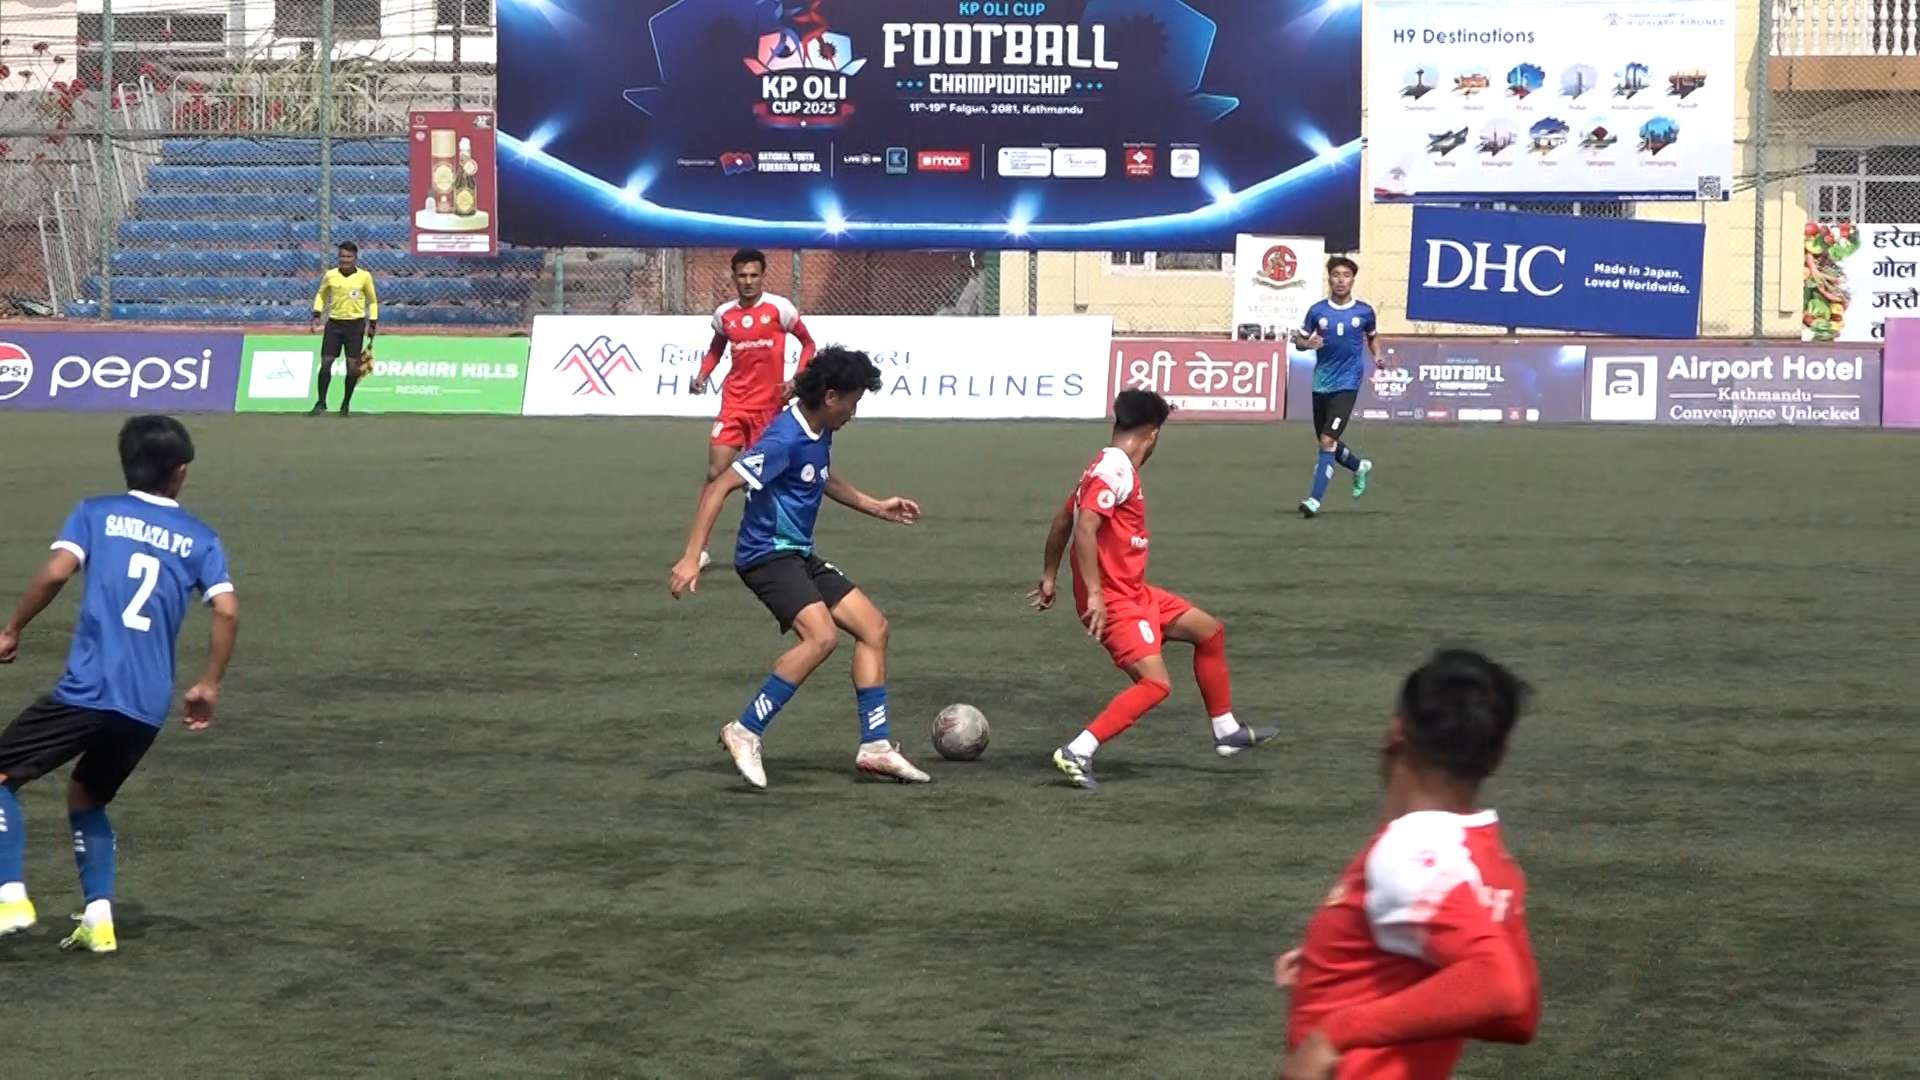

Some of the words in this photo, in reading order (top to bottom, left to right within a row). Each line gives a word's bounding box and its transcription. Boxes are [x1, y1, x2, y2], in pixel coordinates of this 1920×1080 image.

[959, 2, 980, 16] KP
[983, 3, 1009, 16] OLI
[1013, 3, 1045, 16] CUP
[1394, 28, 1416, 44] H9
[1423, 28, 1535, 44] Destinations
[882, 23, 1119, 70] FOOTBALL
[762, 75, 797, 99] KP
[803, 75, 847, 99] OLI
[929, 73, 1072, 95] CHAMPIONSHIP
[772, 101, 800, 114] CUP
[803, 101, 836, 114] 2025
[1023, 104, 1084, 115] Kathmandu
[758, 152, 790, 162] NATIONAL
[793, 152, 815, 162] YOUTH
[758, 163, 799, 173] FEDERATION
[800, 163, 822, 173] NEPAL
[1422, 239, 1566, 296] DHC
[1594, 262, 1626, 276] Made
[1629, 264, 1640, 276] in
[1643, 267, 1683, 280] Japan.
[1873, 256, 1917, 278] गोल
[1585, 277, 1620, 289] Loved
[1622, 279, 1691, 295] Worldwide.
[49, 348, 212, 398] pepsi
[318, 360, 456, 378] HDRAGIRI
[462, 361, 519, 379] HILLS
[1127, 350, 1177, 392] श्री
[1185, 351, 1269, 394] केश
[1419, 365, 1504, 382] FOOTBALL
[1667, 356, 1773, 384] Airport
[1783, 357, 1862, 380] Hotel
[395, 385, 439, 395] RESORT
[890, 374, 1083, 396] AIRLINES
[1718, 387, 1812, 402] Kathmandu
[1670, 405, 1776, 421] Convenience
[1781, 405, 1860, 422] Unlocked
[105, 514, 169, 550] SANKATA
[170, 533, 193, 558] FC
[121, 552, 160, 632] 2
